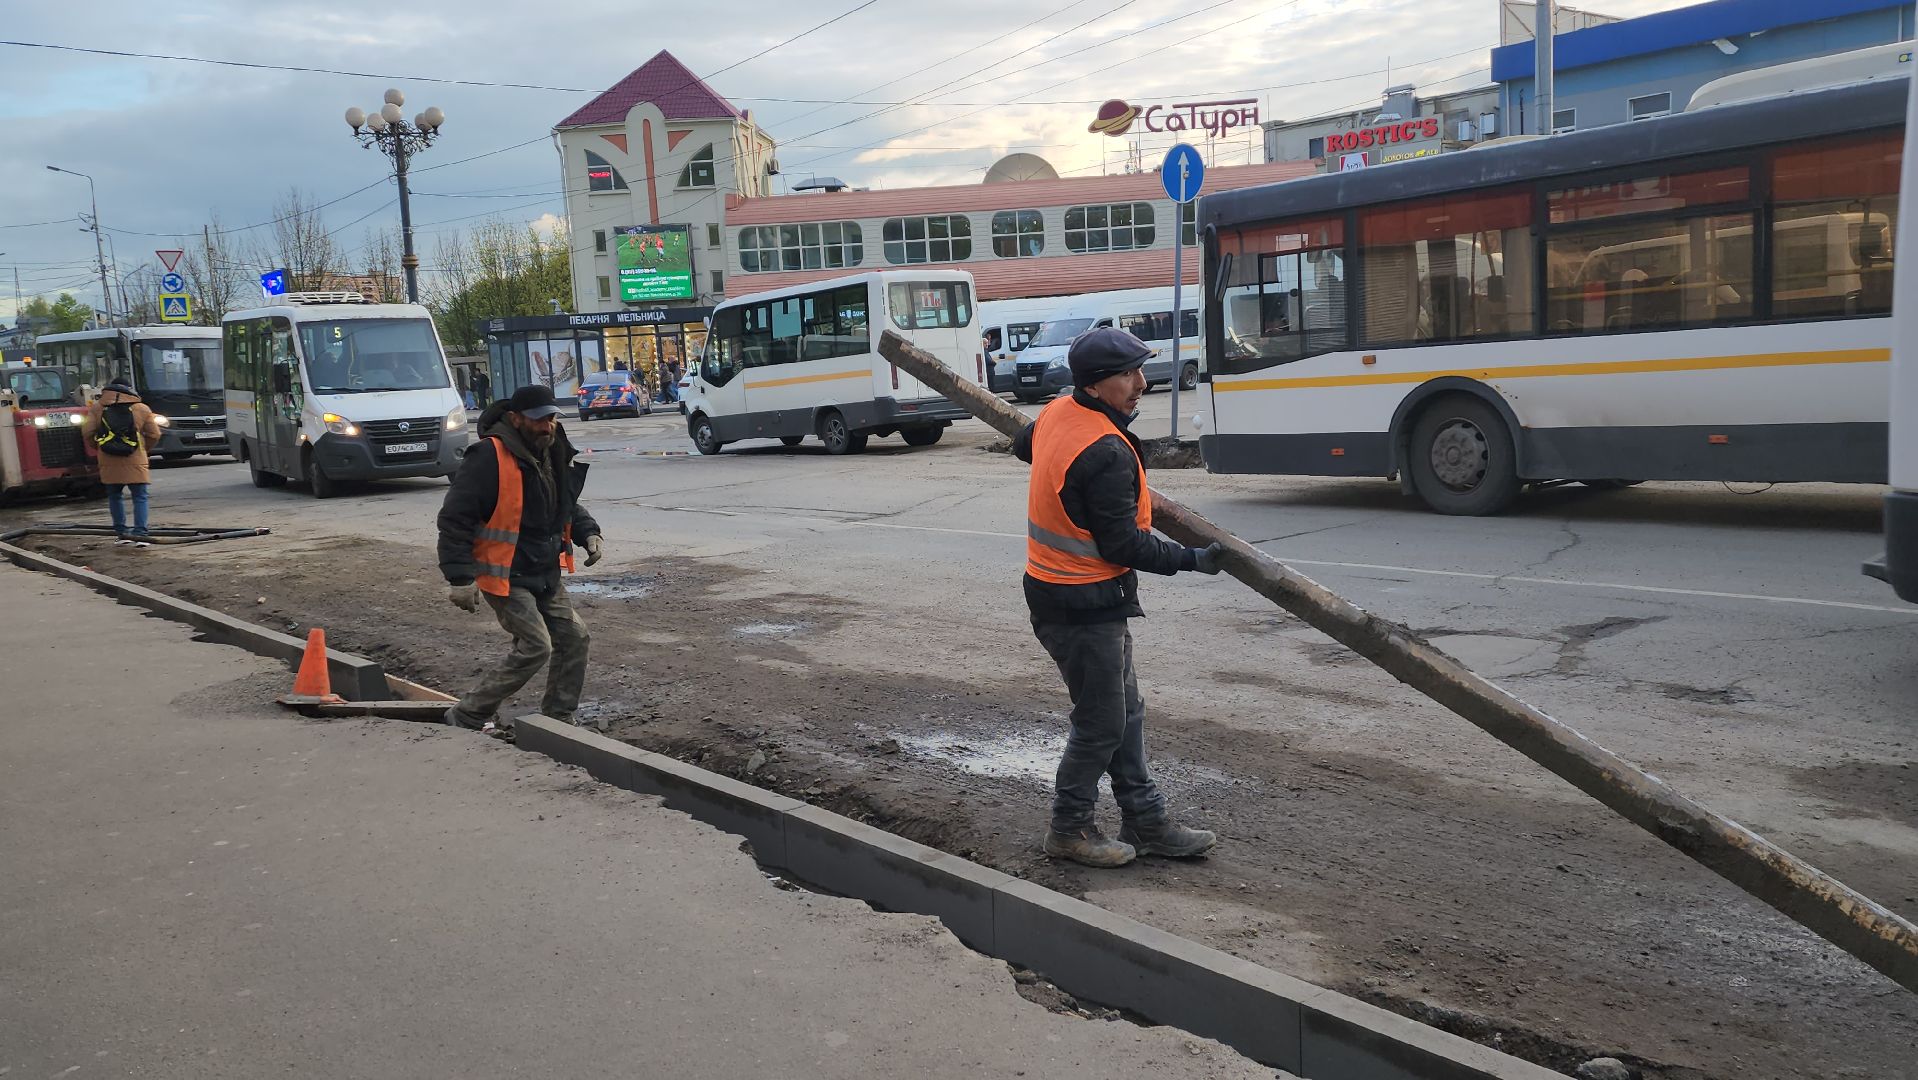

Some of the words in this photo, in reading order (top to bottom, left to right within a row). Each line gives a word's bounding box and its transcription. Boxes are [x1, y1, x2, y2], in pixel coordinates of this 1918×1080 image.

[1327, 118, 1438, 153] ROSTIC'S
[569, 314, 610, 325] ПЕКАРНЯ
[617, 311, 666, 323] МЕЛЬНИЦА
[334, 327, 341, 338] 5
